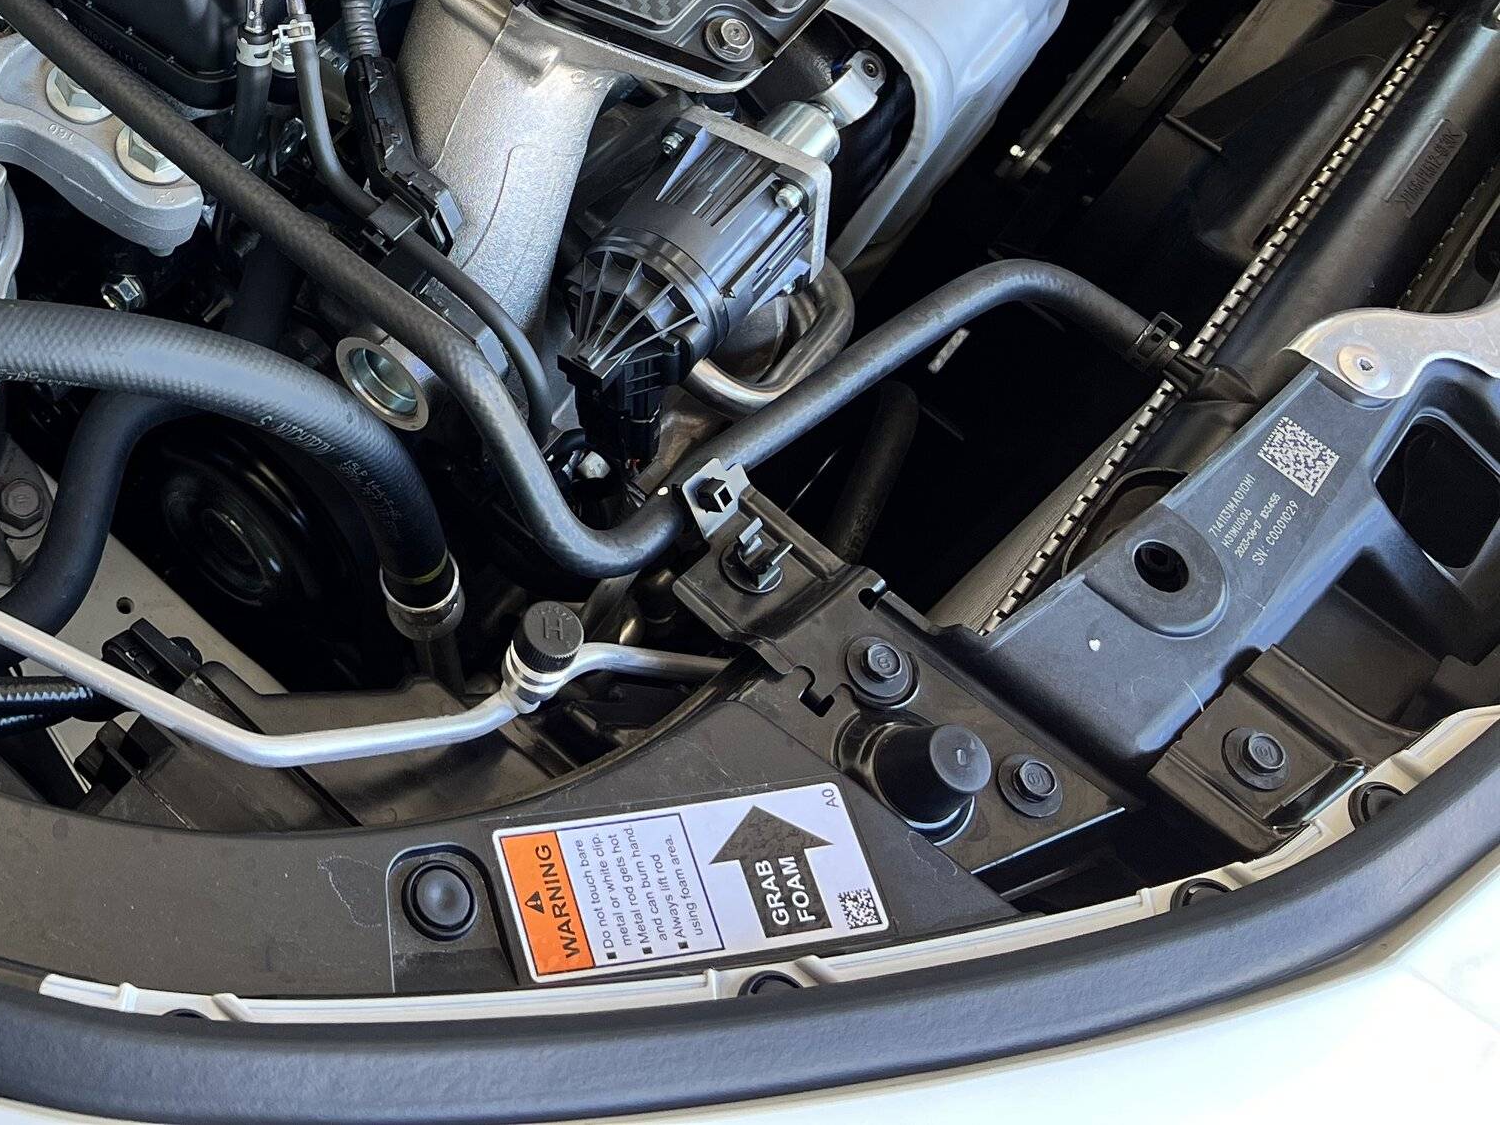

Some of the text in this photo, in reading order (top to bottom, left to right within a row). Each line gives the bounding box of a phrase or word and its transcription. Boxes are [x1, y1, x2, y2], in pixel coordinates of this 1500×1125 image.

[535, 844, 581, 958] WARNING
[575, 840, 614, 949] Do not touch bare
[592, 833, 632, 946] metal or white clip.
[608, 834, 650, 944] Metal rod gets hot
[624, 824, 667, 941] and can burn hand.
[650, 854, 686, 938] Always lift rod
[665, 834, 703, 936] using foam area.
[754, 859, 790, 926] GRAB
[778, 856, 816, 923] FOAM
